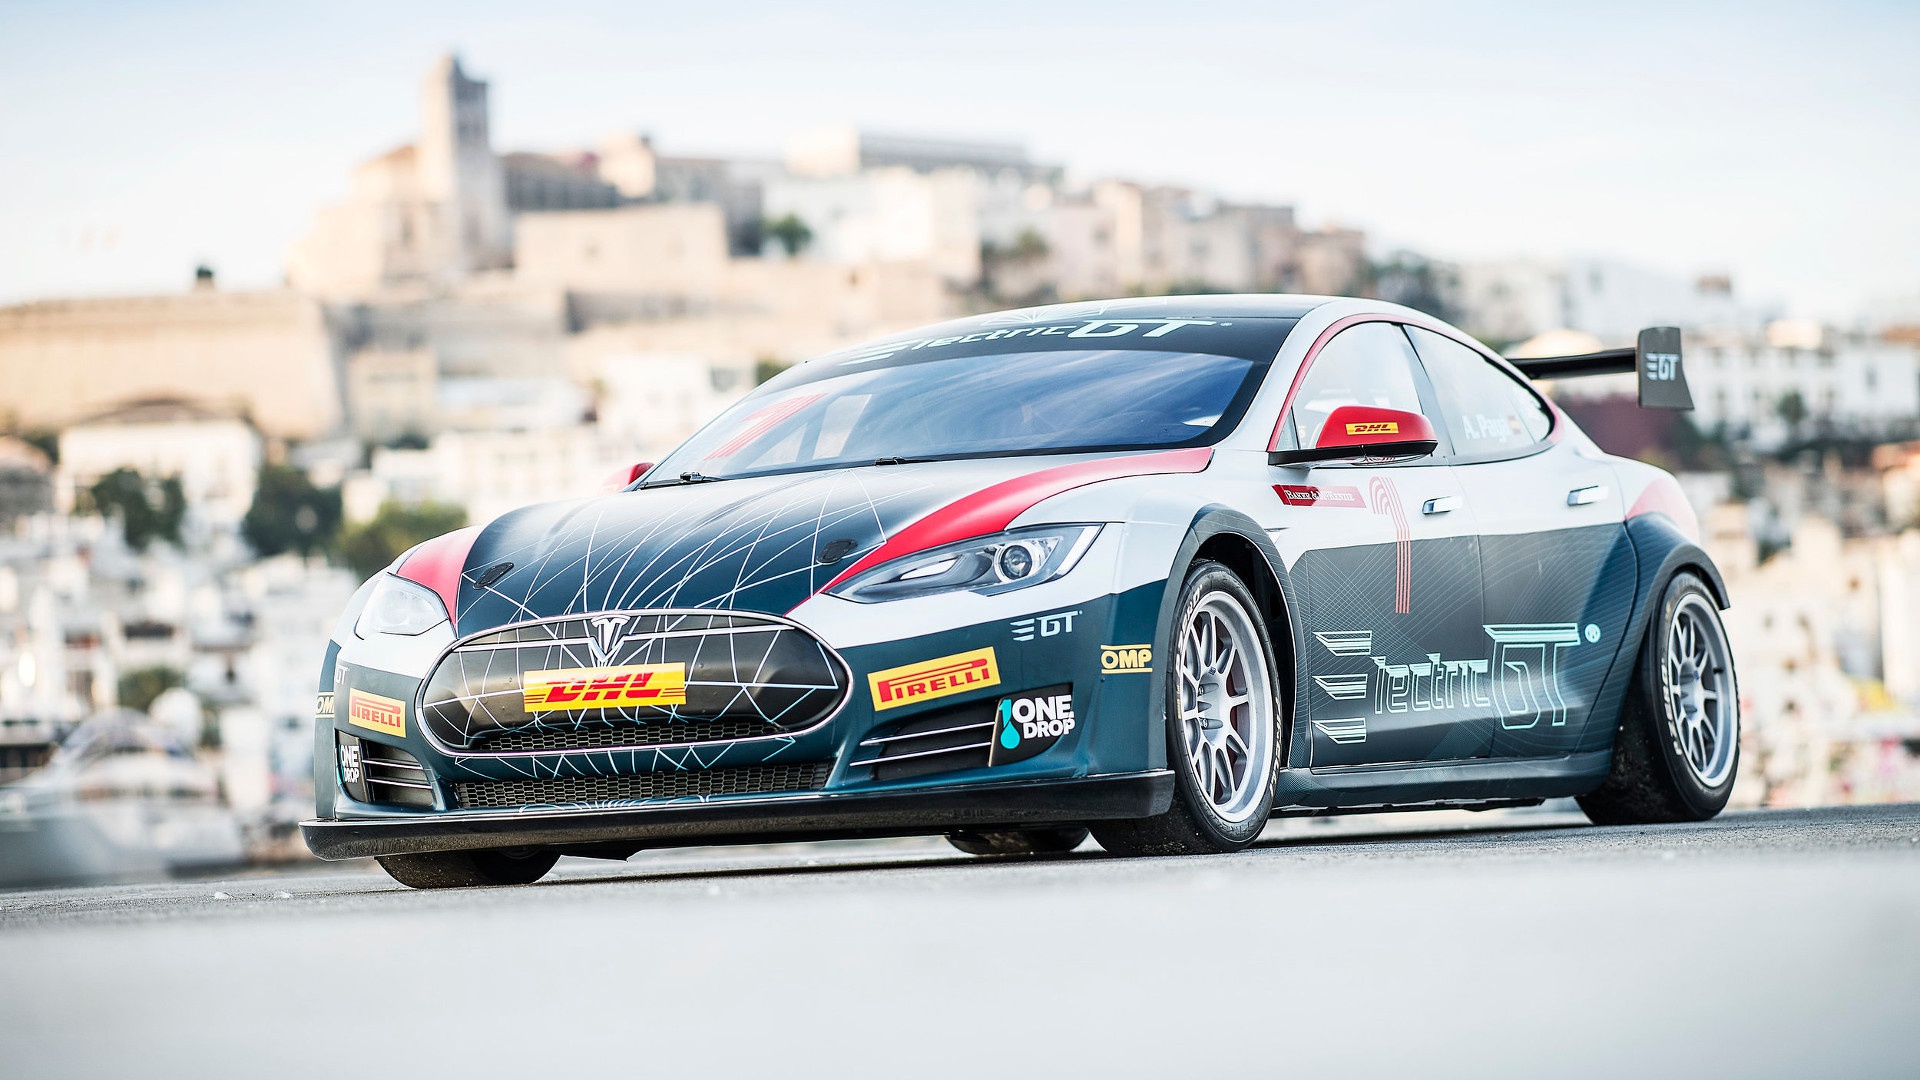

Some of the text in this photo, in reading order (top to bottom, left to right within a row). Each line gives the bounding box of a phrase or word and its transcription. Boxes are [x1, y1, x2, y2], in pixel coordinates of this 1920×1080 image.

[1354, 424, 1391, 433] DHL
[1101, 648, 1152, 670] OMP
[545, 672, 662, 703] DHL
[876, 658, 990, 702] PIRELLI
[315, 696, 335, 714] OM
[351, 695, 401, 728] PIRELLI
[1012, 695, 1072, 723] ONE
[1023, 718, 1076, 739] DROP
[340, 744, 360, 768] ONE
